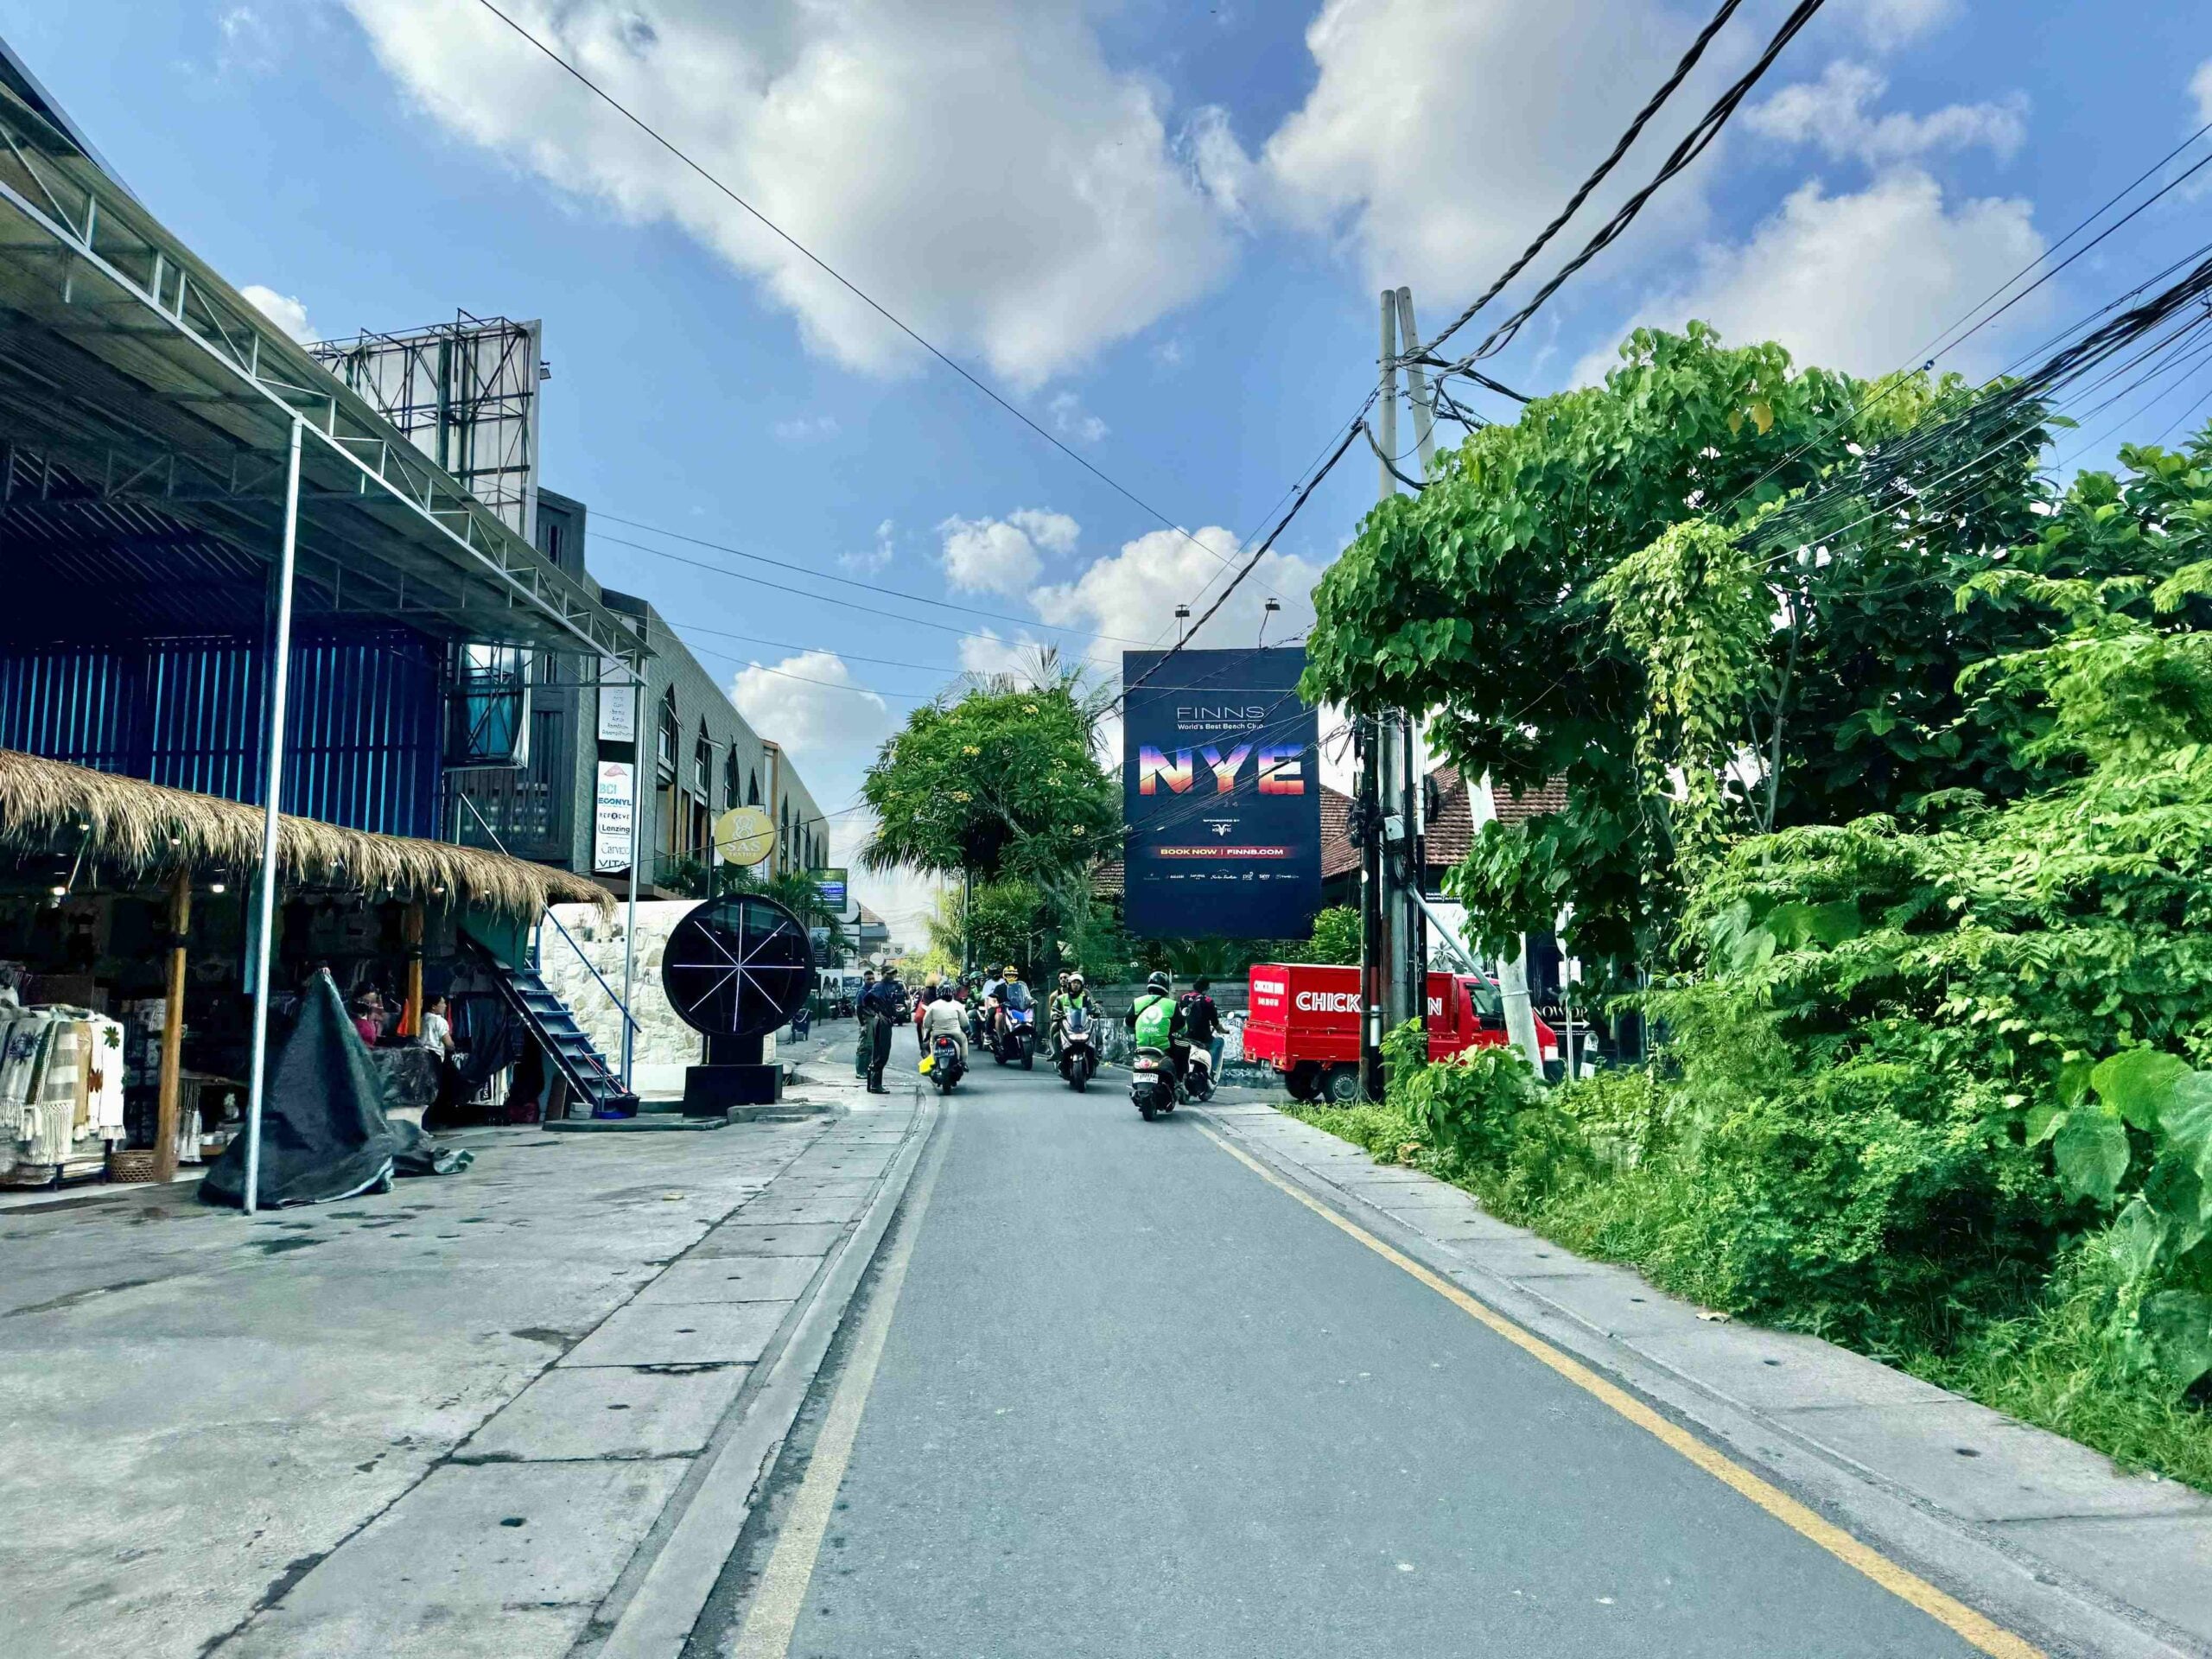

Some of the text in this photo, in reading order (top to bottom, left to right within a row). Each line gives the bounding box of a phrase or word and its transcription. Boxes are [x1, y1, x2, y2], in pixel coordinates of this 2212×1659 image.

[1177, 706, 1264, 719] FINNS
[1139, 744, 1305, 795] NYE
[599, 784, 617, 794] BCI
[601, 823, 631, 834] Lenzing
[726, 841, 761, 852] SAS
[598, 859, 628, 868] VITA
